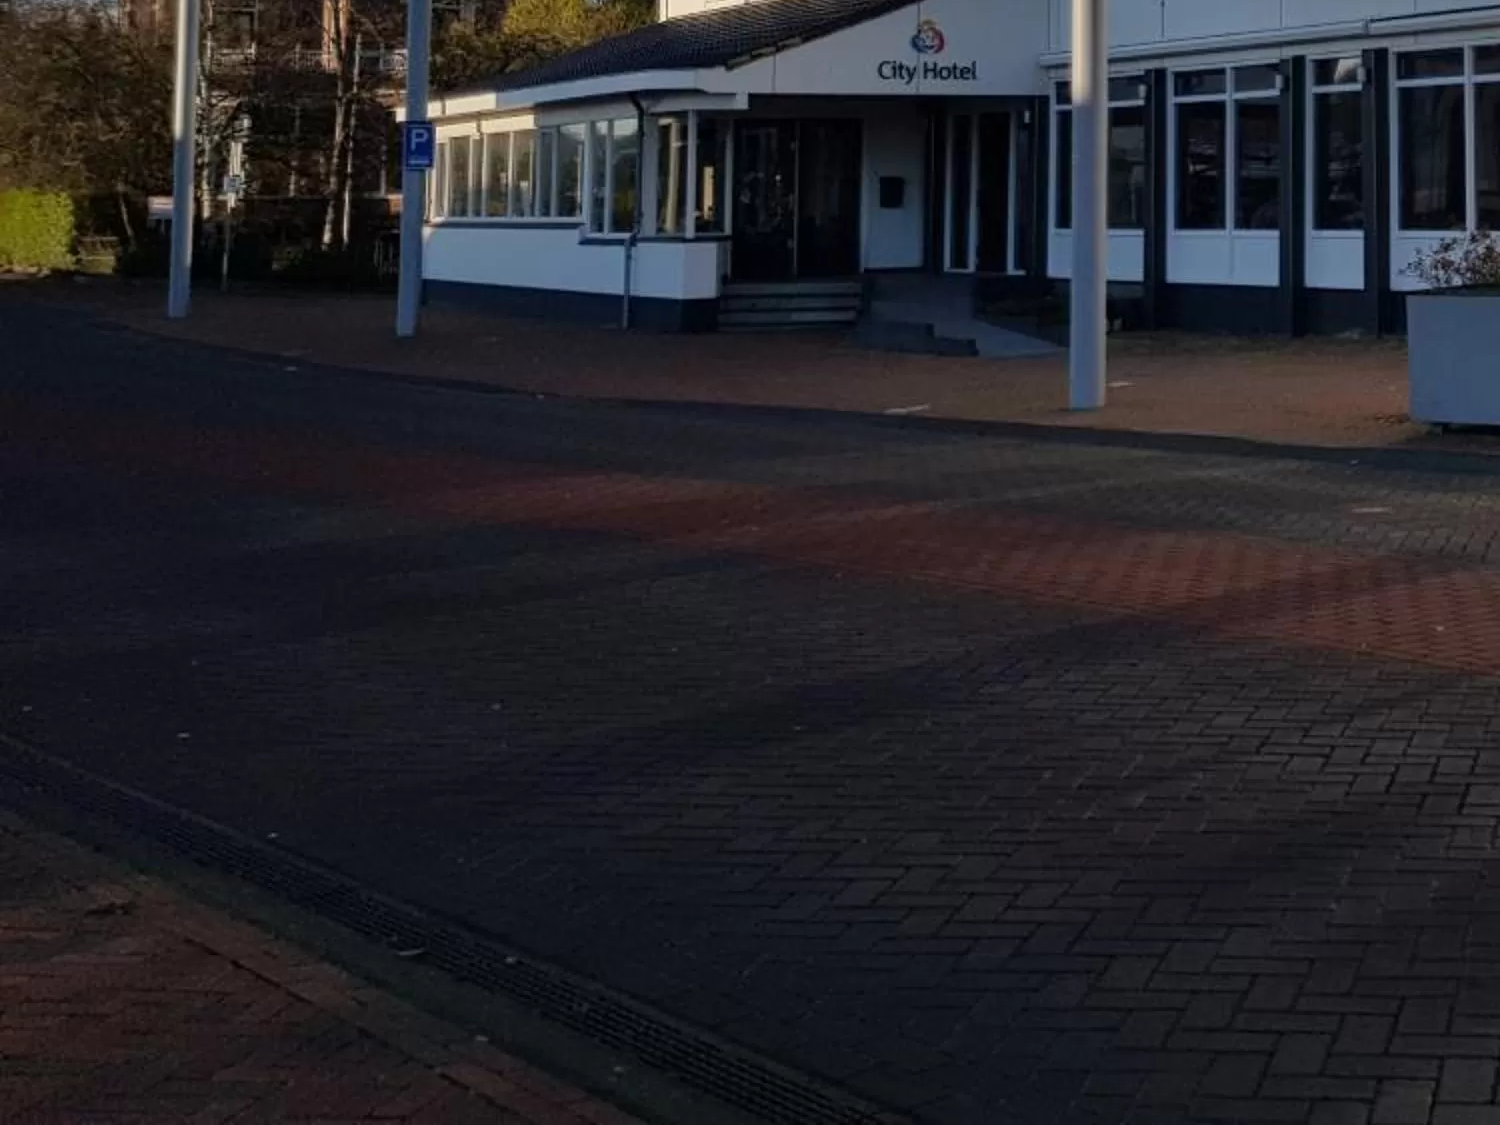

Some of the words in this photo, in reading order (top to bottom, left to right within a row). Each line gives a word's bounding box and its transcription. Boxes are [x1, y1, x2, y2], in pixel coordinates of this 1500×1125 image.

[877, 60, 917, 85] City
[923, 60, 977, 81] Hotel
[410, 128, 429, 152] P
